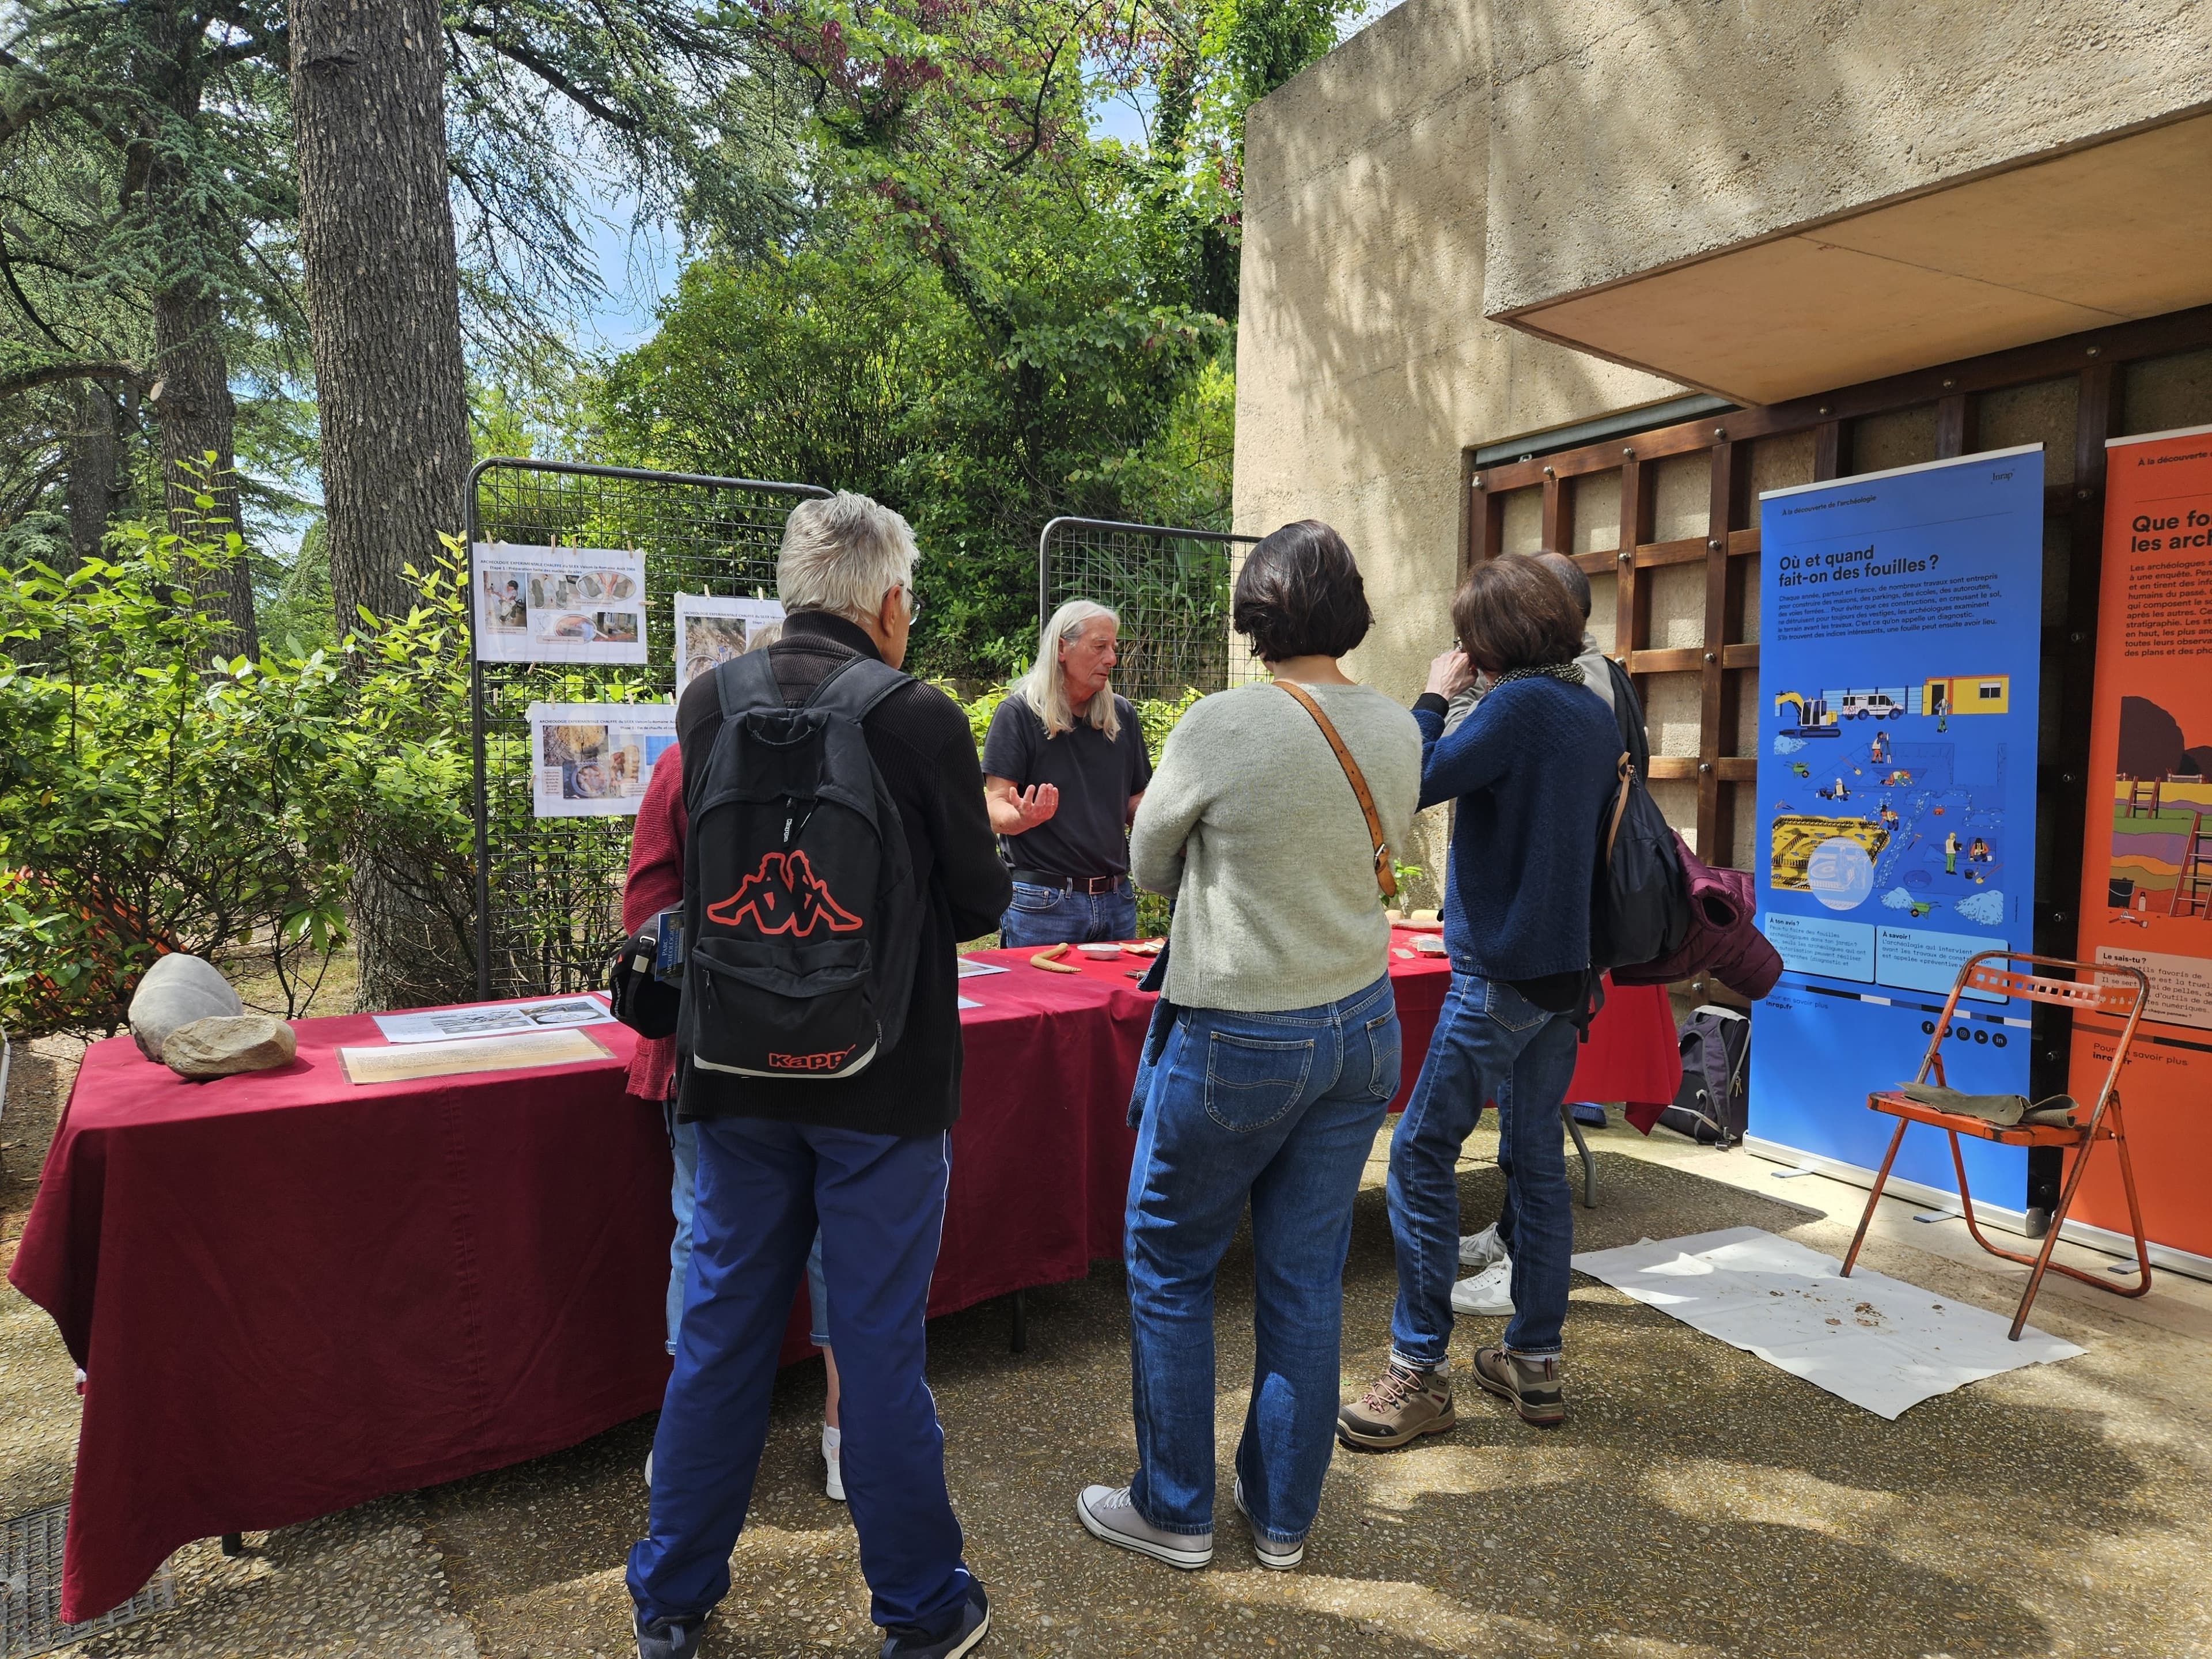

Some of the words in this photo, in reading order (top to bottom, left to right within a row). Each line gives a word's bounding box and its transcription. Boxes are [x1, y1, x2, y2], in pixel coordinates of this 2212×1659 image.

[2157, 452, 2207, 464] découverte
[1794, 502, 1827, 514] découverte
[1837, 495, 1877, 507] l'archéologie
[2133, 515, 2180, 532] Que
[2187, 510, 2212, 527] fo
[2131, 536, 2161, 553] les
[1780, 555, 1800, 570] Où
[1805, 554, 1820, 567] et
[1825, 544, 1874, 567] quand
[2147, 560, 2206, 569] archéologues
[1779, 571, 1827, 587] fait-on
[1833, 566, 1859, 581] des
[2156, 570, 2192, 579] enquête.
[1823, 589, 1843, 598] partout
[1967, 573, 1997, 582] entrepris
[2153, 581, 2176, 589] tirent
[1793, 600, 1820, 608] construire
[1873, 593, 1900, 601] parkings,
[1953, 584, 1991, 592] autoroutes,
[1891, 598, 1937, 607] constructions,
[1949, 593, 1978, 601] creusant
[2128, 592, 2164, 600] humains
[2180, 589, 2206, 598] passé.
[2128, 602, 2141, 610] qui
[2143, 599, 2191, 608] composent
[1786, 616, 1814, 624] détruisent
[1909, 605, 1952, 613] archéologues
[1954, 601, 1988, 609] examinent
[2127, 612, 2150, 620] après
[2126, 619, 2182, 628] stratigraphie.
[2177, 628, 2196, 637] plus
[2142, 649, 2164, 657] plans
[1883, 940, 1923, 949] L'archéologie
[1939, 946, 1972, 955] intervient
[1949, 955, 1991, 965] constion
[2114, 955, 2141, 964] sais-tu
[2158, 968, 2189, 978] favoris
[2155, 992, 2188, 1002] d'outils
[1766, 1000, 1793, 1009] inrap.fr
[2162, 1002, 2210, 1013] numériques.
[2092, 1052, 2133, 1065] inrafr
[2093, 1043, 2115, 1052] Pour
[2133, 1051, 2164, 1061] savoir
[2166, 1056, 2188, 1066] plus
